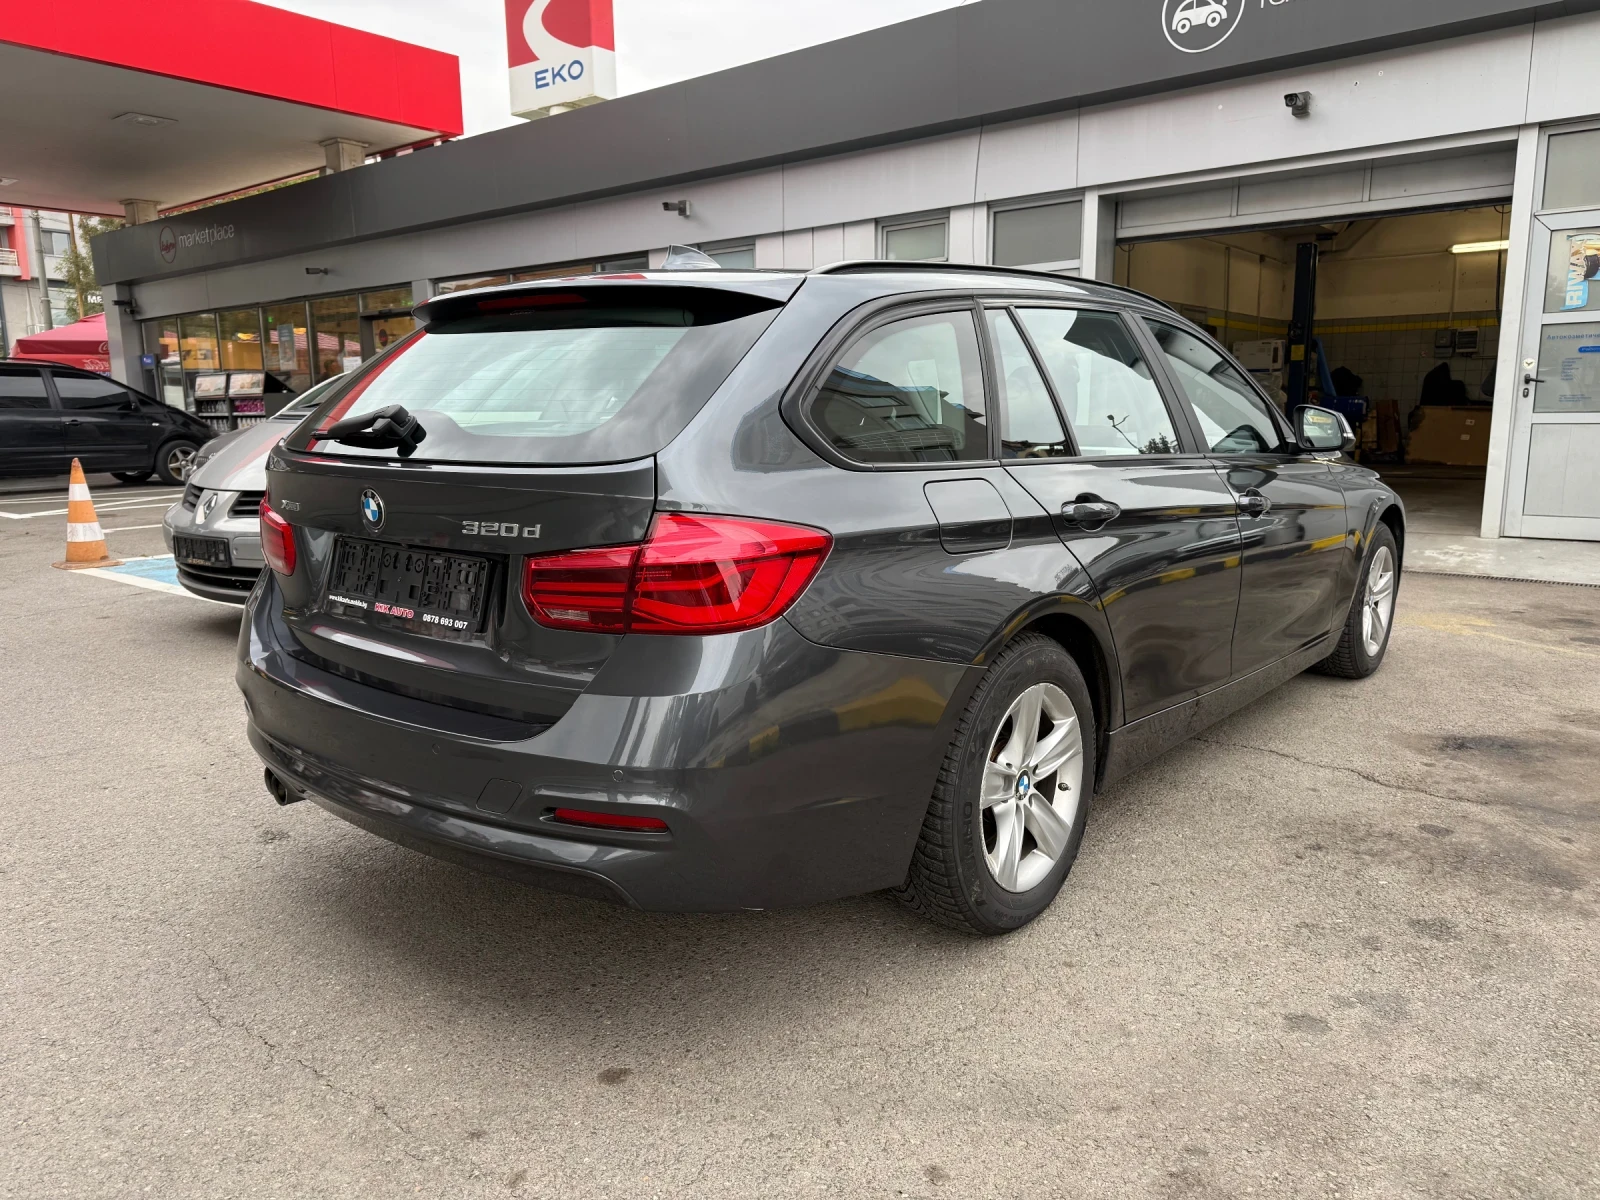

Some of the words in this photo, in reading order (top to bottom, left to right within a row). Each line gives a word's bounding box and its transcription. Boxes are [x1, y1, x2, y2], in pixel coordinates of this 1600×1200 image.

[534, 59, 584, 90] EKO
[178, 223, 235, 248] marketplace
[390, 606, 415, 619] AUTO
[422, 613, 440, 624] 0878
[440, 617, 454, 627] 693
[454, 620, 469, 630] 007
